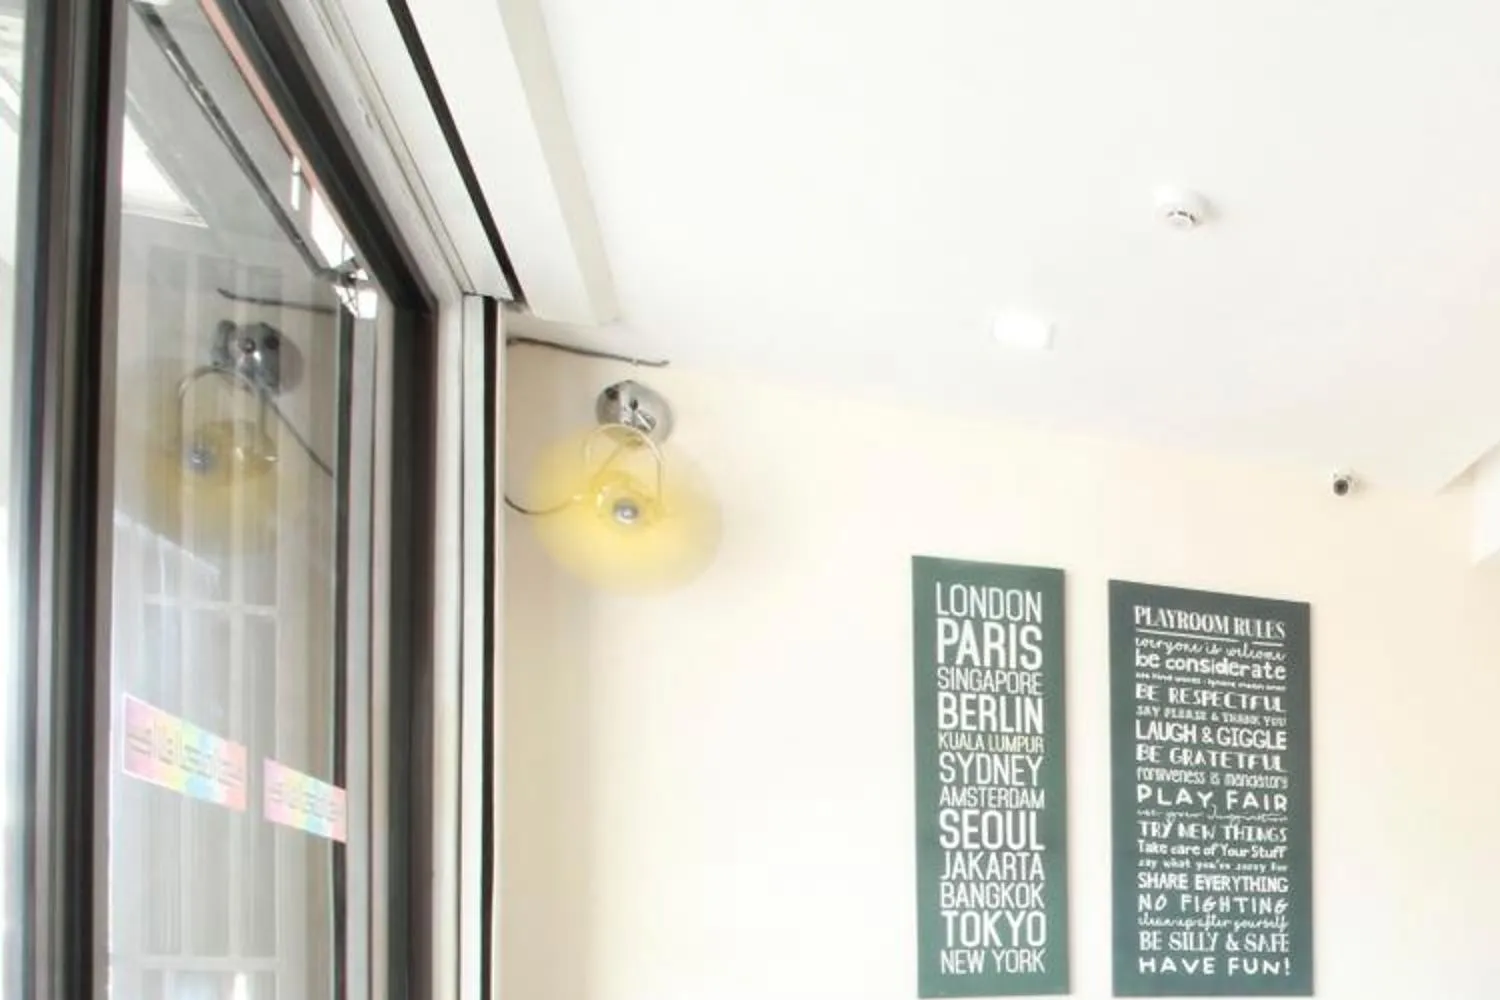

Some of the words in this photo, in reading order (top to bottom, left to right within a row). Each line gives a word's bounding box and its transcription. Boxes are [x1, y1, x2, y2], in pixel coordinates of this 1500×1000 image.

[935, 581, 1043, 623] LONDON
[1134, 605, 1229, 635] PLAYROOM
[1233, 617, 1286, 640] RULES
[936, 617, 1043, 671] PARIS
[1135, 647, 1161, 669] be
[1165, 657, 1287, 680] considerate
[937, 666, 1044, 696] SINGAPORE
[1135, 683, 1162, 701] BE
[1168, 687, 1288, 712] RESPECTFUL
[937, 691, 1044, 734] BERLIN
[1263, 714, 1287, 727] YOU
[938, 732, 985, 751] KUALA
[988, 733, 1045, 753] LUMPUR
[1135, 719, 1197, 744] LAUGH
[1201, 726, 1214, 744] &
[1216, 726, 1287, 751] GIGGLE
[1135, 743, 1163, 763] BE
[939, 751, 1044, 787] SYDNEY
[939, 786, 1045, 809] AMSTERDAM
[1137, 783, 1213, 809] PLAY
[1225, 789, 1288, 812] FAIR
[939, 808, 1045, 851] SEOUL
[1136, 820, 1174, 838] TRY
[1177, 823, 1217, 840] NEW
[1220, 825, 1288, 842] THINGS
[1137, 839, 1168, 855] Take
[1170, 844, 1201, 856] care
[1203, 842, 1219, 857] of
[1219, 842, 1250, 857] Your
[1251, 845, 1288, 859] Stuff
[939, 850, 1045, 881] JAKARTA
[940, 881, 1045, 909] BANGKOK
[1137, 872, 1189, 891] SHARE
[1194, 873, 1289, 893] EVERYTHING
[1138, 893, 1168, 913] NO
[1181, 893, 1289, 915] FIGHTING
[940, 909, 1047, 947] TOKYO
[1138, 930, 1163, 951] BE
[1168, 930, 1219, 952] SILLY
[1225, 932, 1240, 952] &
[1244, 932, 1290, 953] SAFE
[940, 948, 985, 975] NEW
[990, 947, 1046, 975] YORK
[1138, 956, 1217, 975] HAVE
[1227, 956, 1291, 977] FUN!
